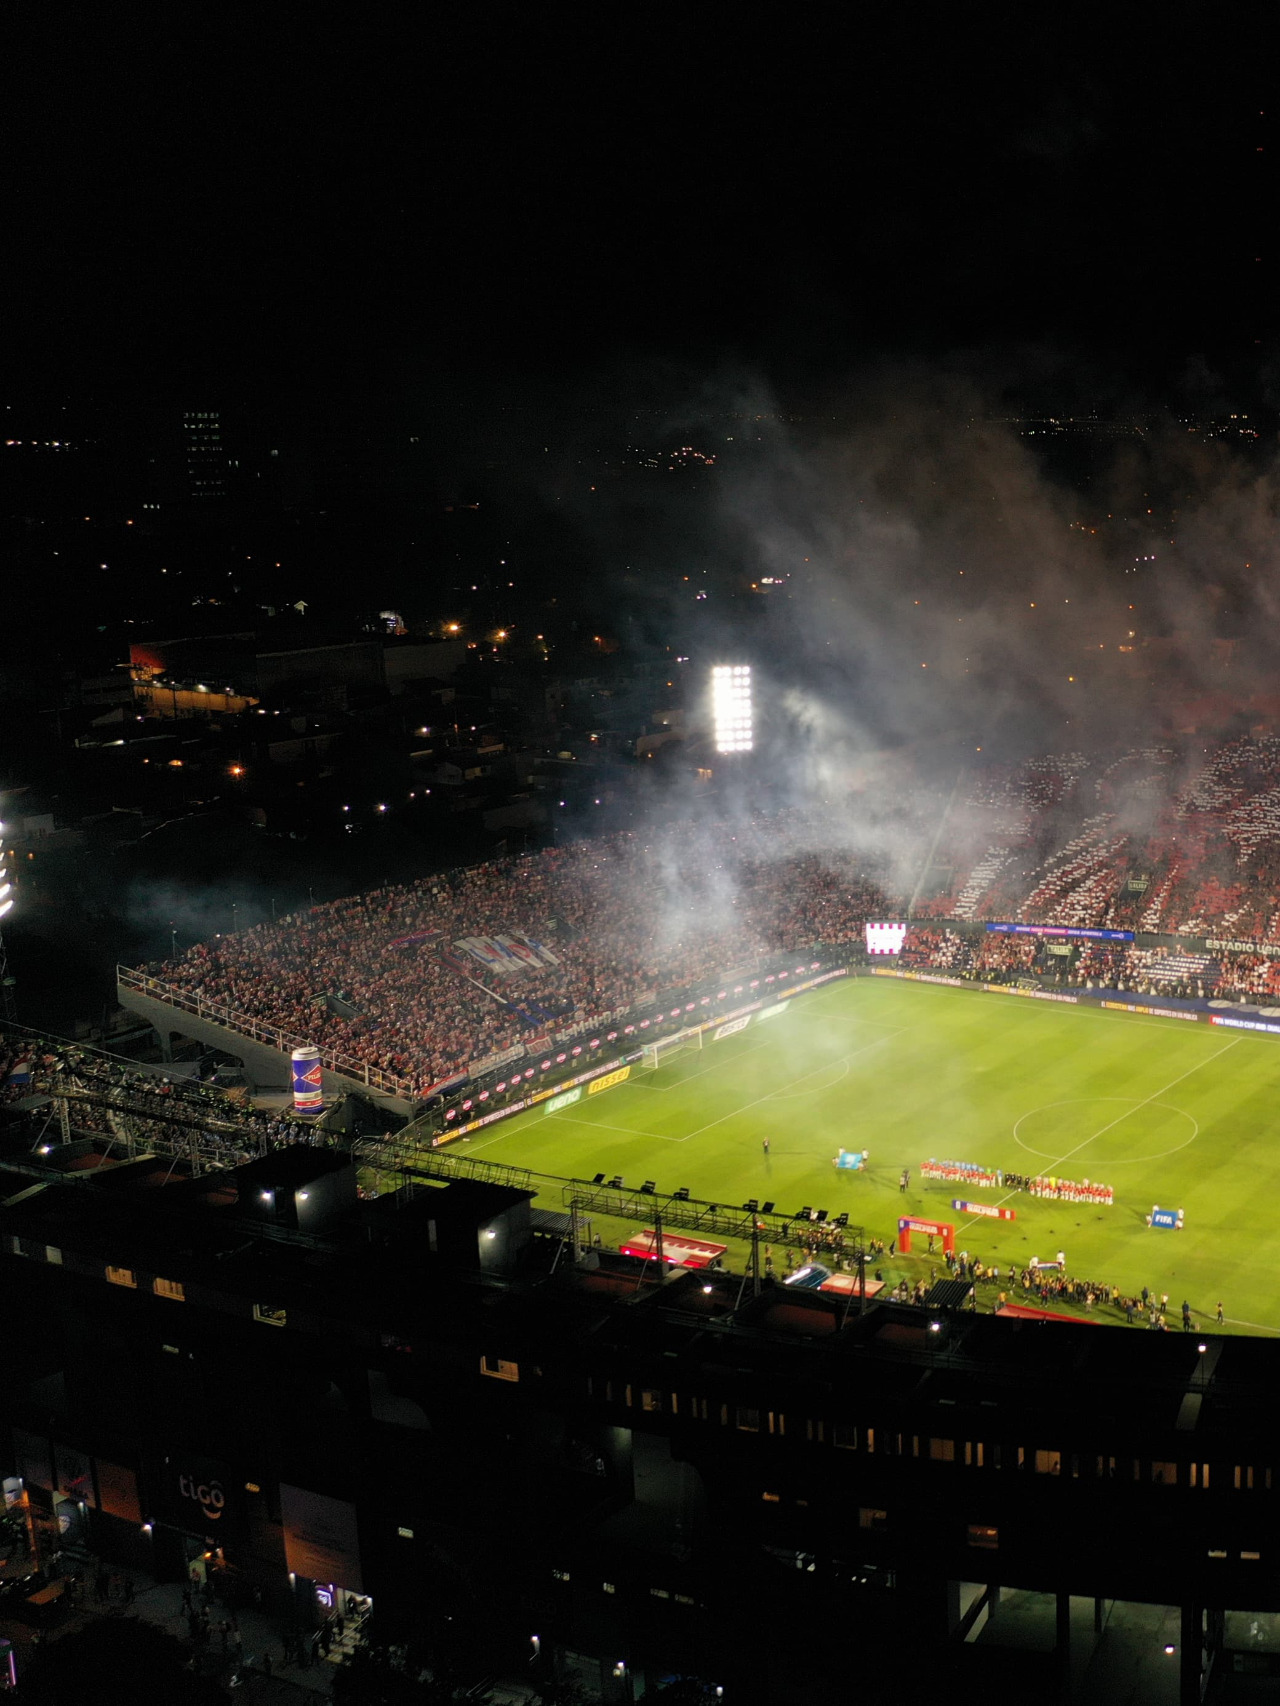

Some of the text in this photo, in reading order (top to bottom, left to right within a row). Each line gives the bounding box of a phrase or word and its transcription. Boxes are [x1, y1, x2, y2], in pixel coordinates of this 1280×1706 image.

[1205, 939, 1254, 953] ESTADIO
[1212, 1016, 1224, 1025] FIFA
[1224, 1017, 1243, 1027] WORLD
[1243, 1020, 1255, 1029] CUP
[549, 1088, 578, 1112] ueno
[1155, 1214, 1173, 1225] FIFA
[179, 1474, 226, 1518] tigo
